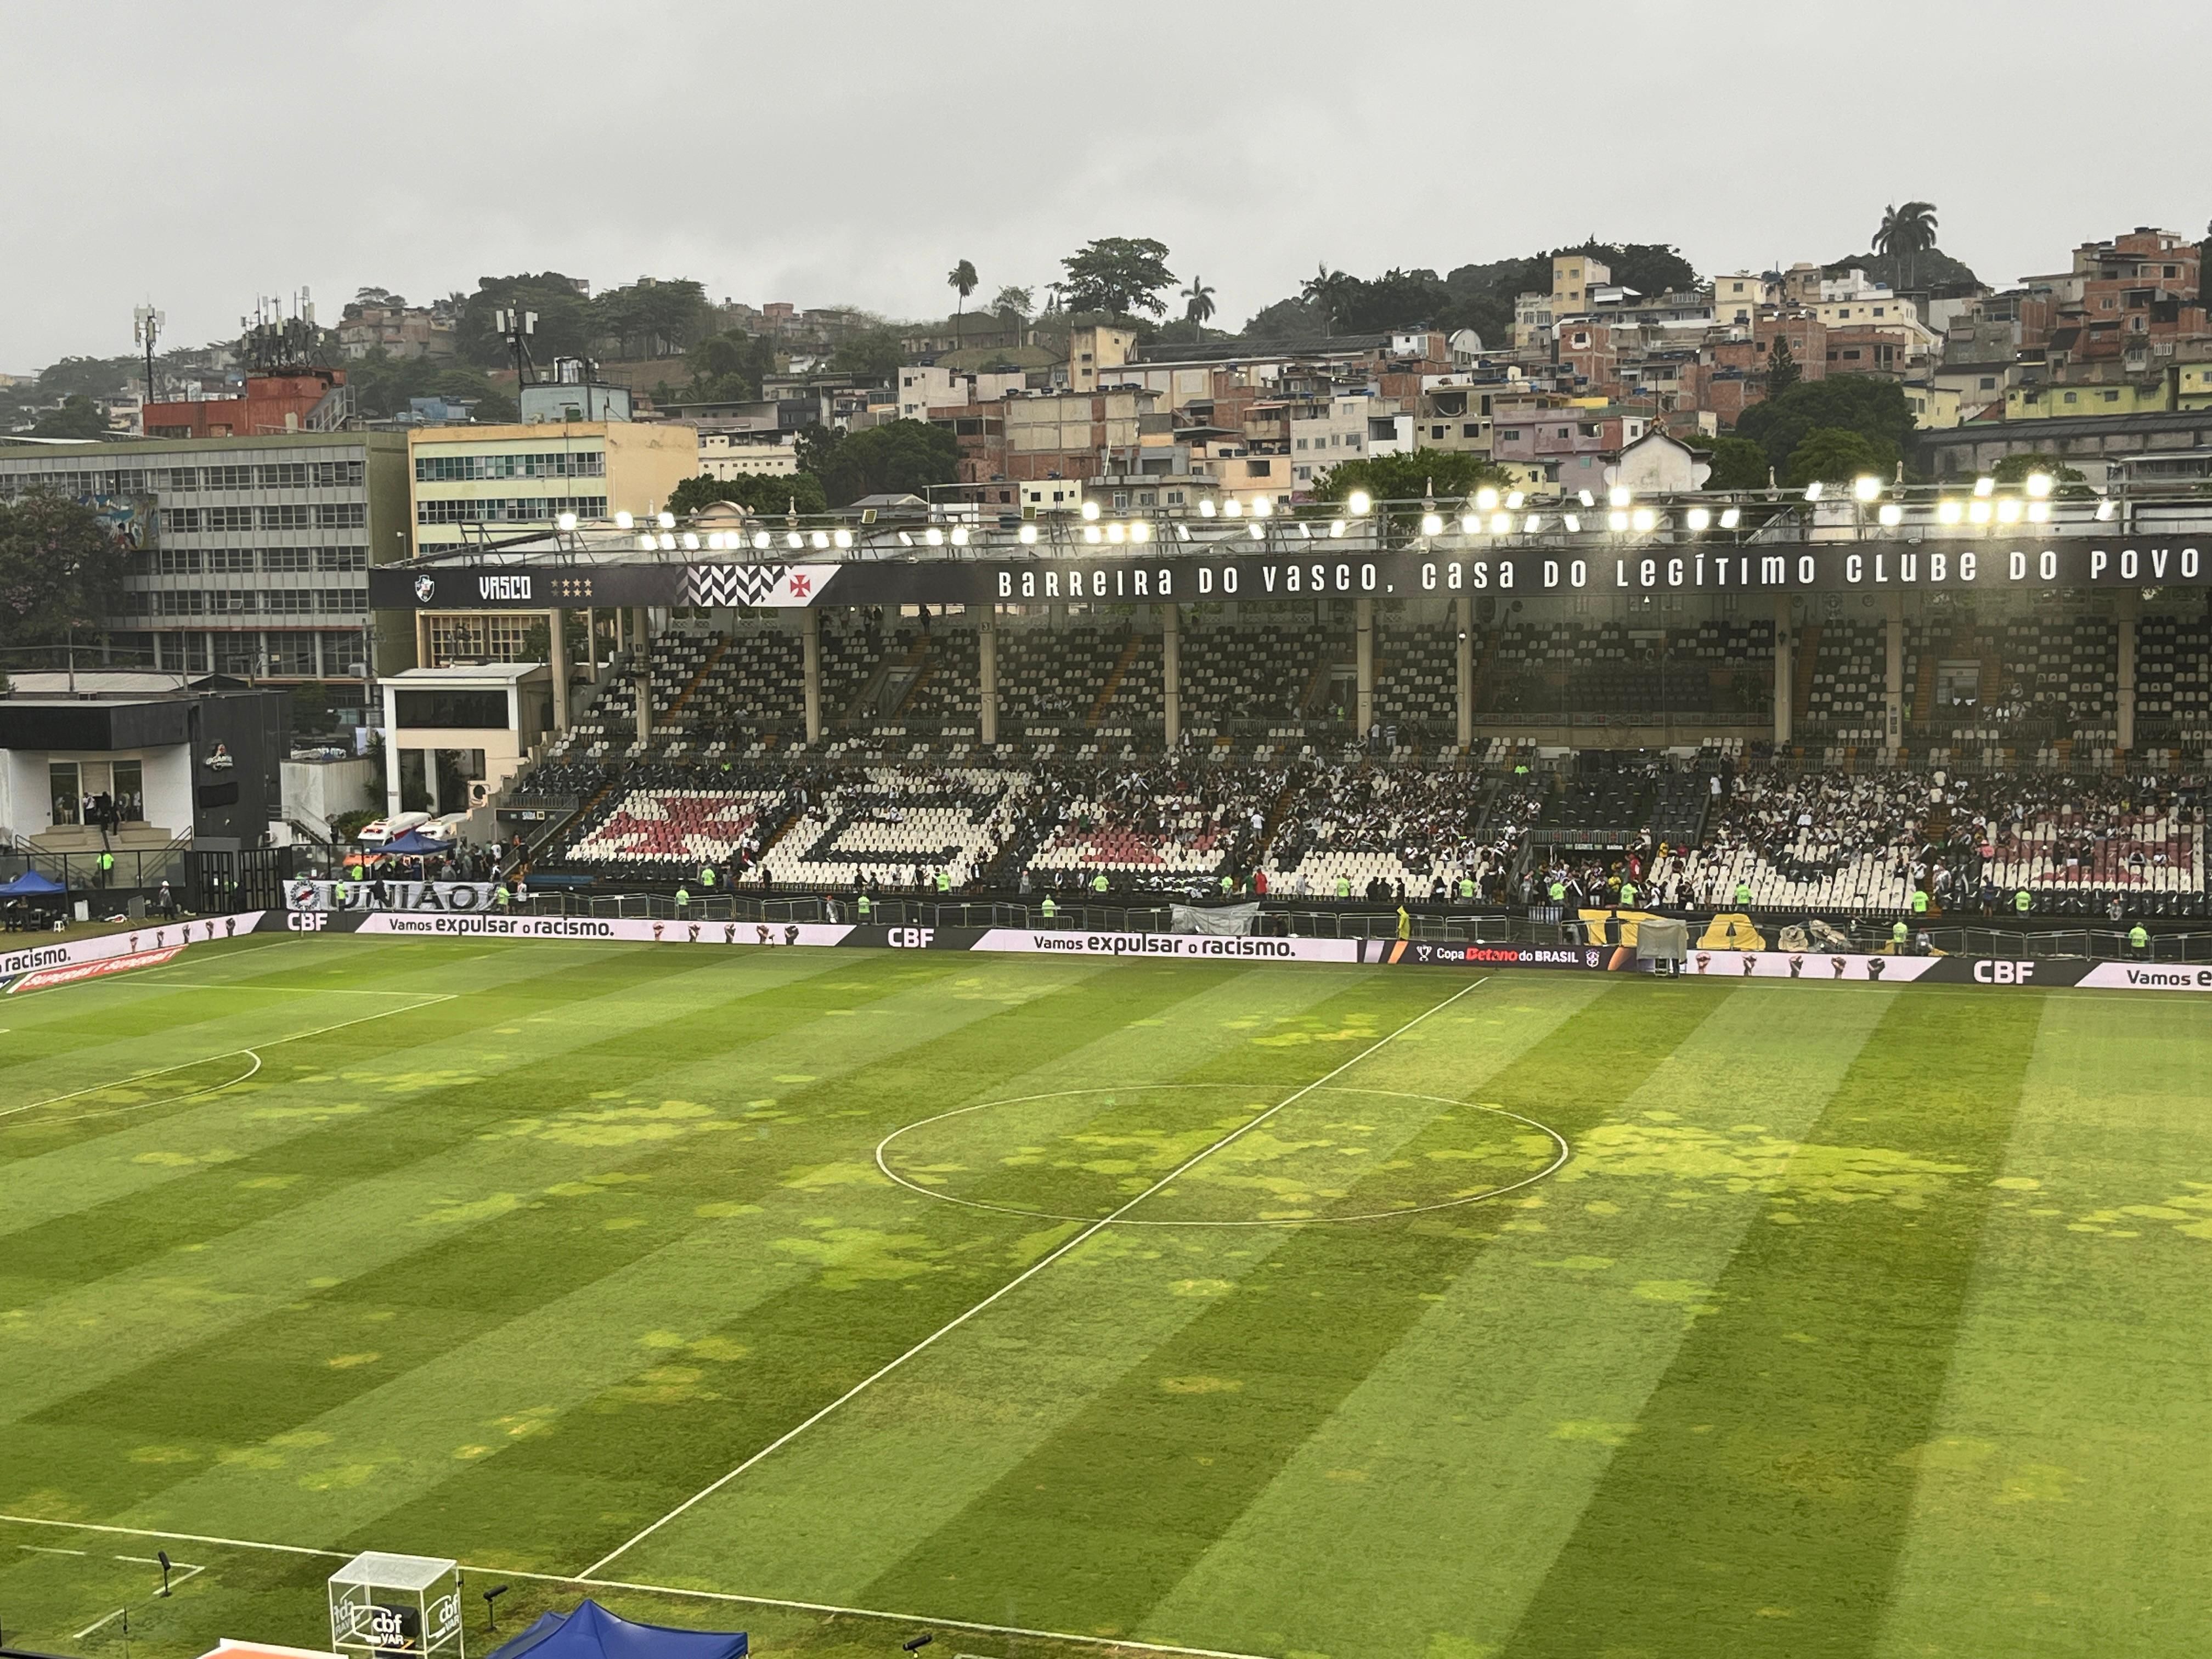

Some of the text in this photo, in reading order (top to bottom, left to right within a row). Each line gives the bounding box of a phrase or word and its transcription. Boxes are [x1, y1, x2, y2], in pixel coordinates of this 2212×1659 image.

[1199, 567, 1238, 593] DO
[1544, 560, 1586, 587] DO
[2010, 551, 2057, 580] DO
[2091, 548, 2199, 579] POVO
[479, 575, 532, 600] VASCO
[287, 912, 328, 931] CBF
[390, 915, 615, 936] Vamos expulsar o racismo.
[888, 928, 934, 948] CBF
[1034, 933, 1296, 957] Vamos expulsar o racismo.
[5, 948, 71, 972] racismo.
[1437, 947, 1579, 963] Copa Betano do BRASIL
[1974, 960, 2035, 984] CBF
[2127, 970, 2191, 986] Vamos
[373, 1612, 402, 1634] cbf
[381, 1633, 404, 1645] VAR
